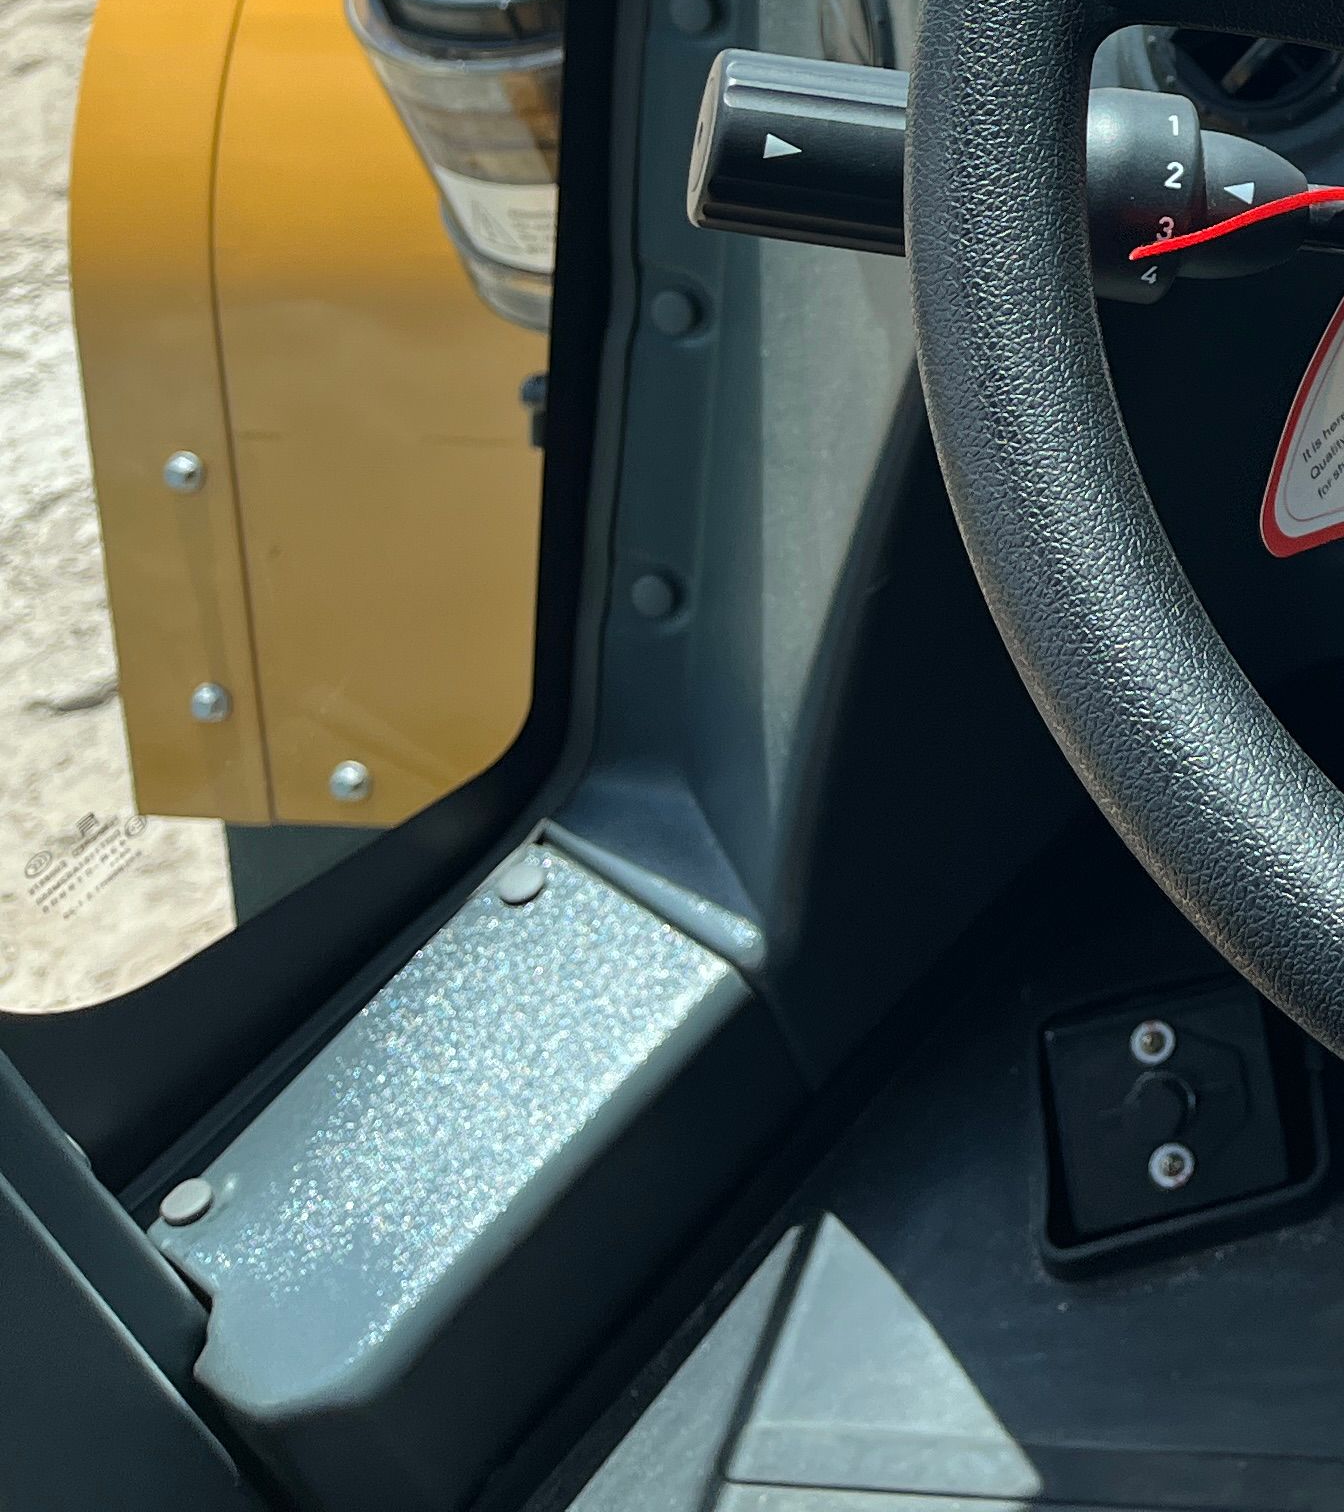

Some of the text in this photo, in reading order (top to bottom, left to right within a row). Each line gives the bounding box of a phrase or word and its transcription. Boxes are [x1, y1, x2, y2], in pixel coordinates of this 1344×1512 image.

[1168, 114, 1180, 137] 1
[1164, 161, 1185, 189] 2
[1156, 216, 1175, 241] 3
[1140, 265, 1158, 284] 4
